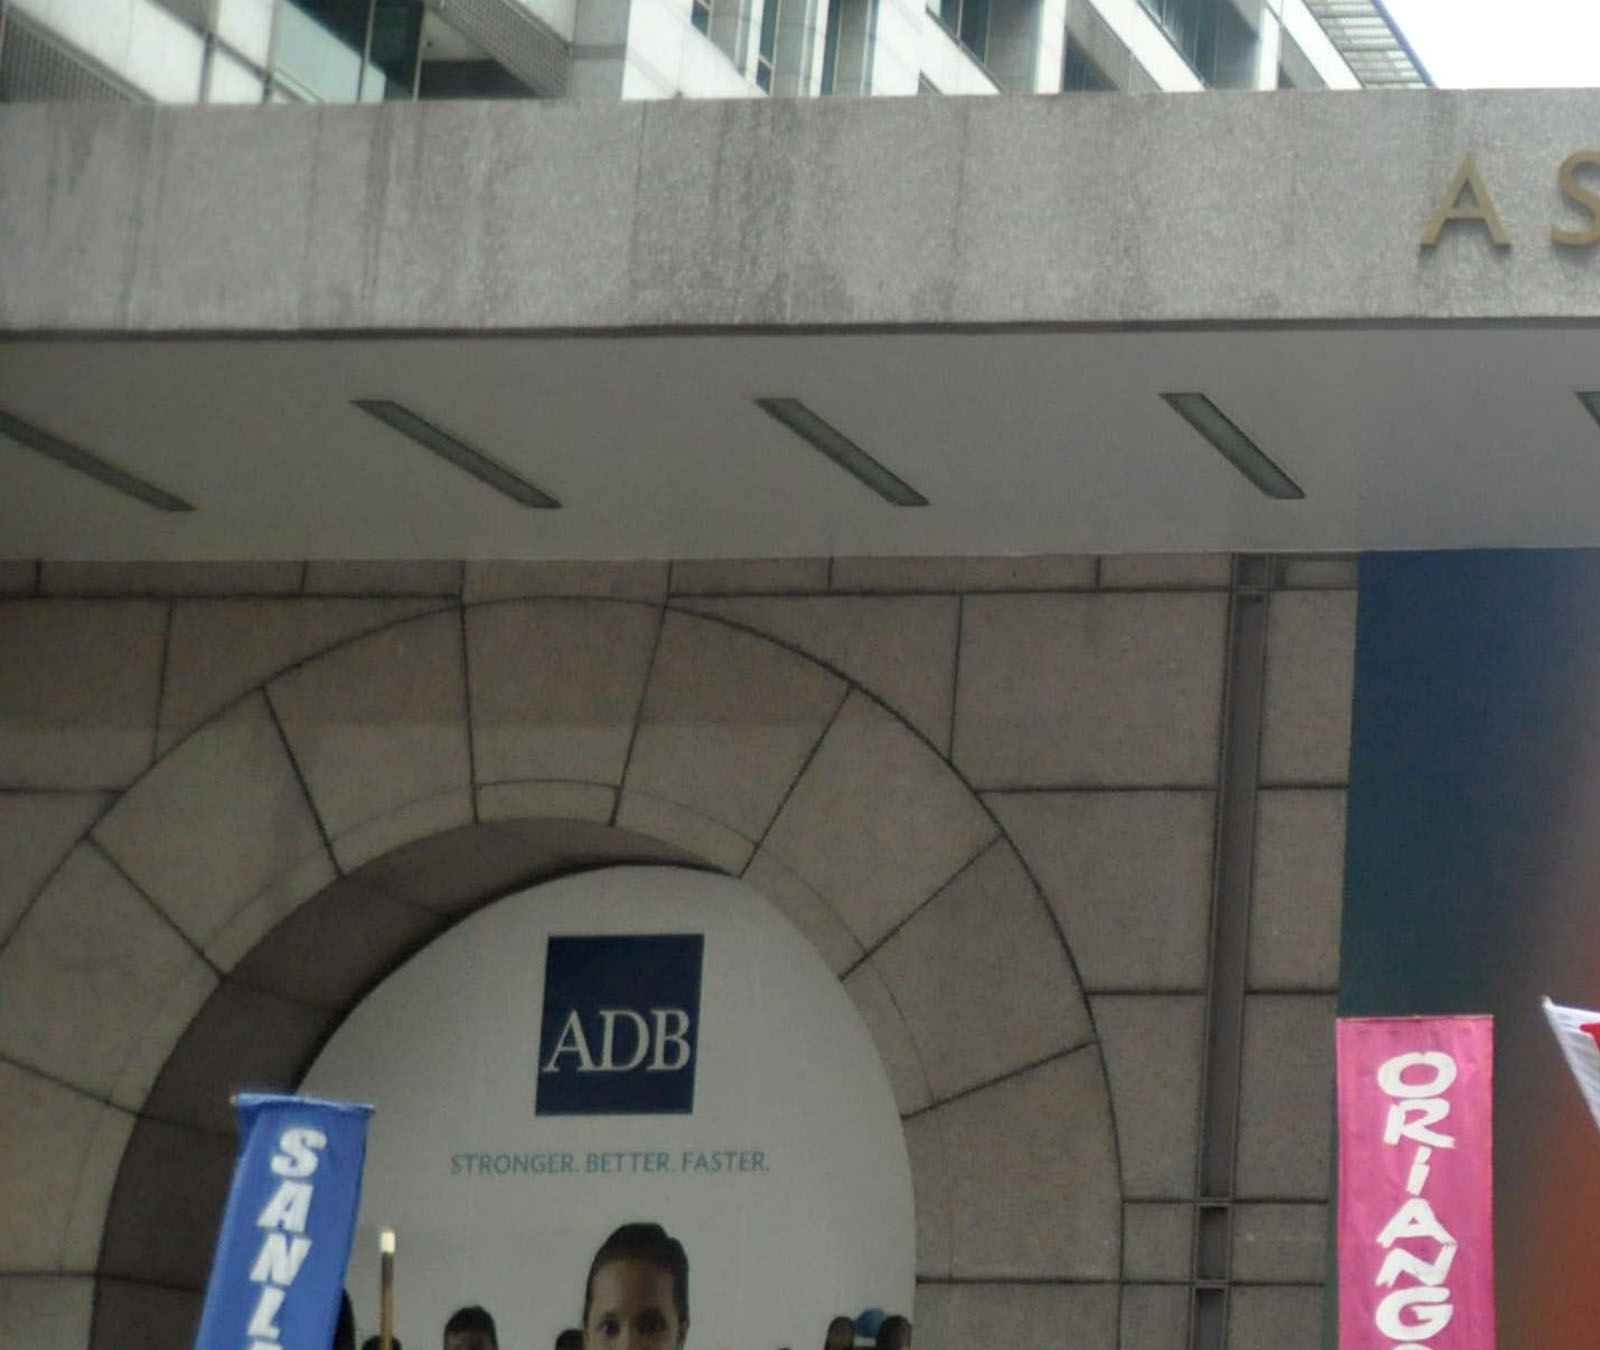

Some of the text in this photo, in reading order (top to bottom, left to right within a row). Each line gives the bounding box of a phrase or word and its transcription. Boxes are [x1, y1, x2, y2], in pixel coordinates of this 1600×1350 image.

[542, 1009, 692, 1073] ADB
[449, 1148, 771, 1176] STRONGER. BETTER. FASTER.
[1375, 1050, 1459, 1340] ORIANG
